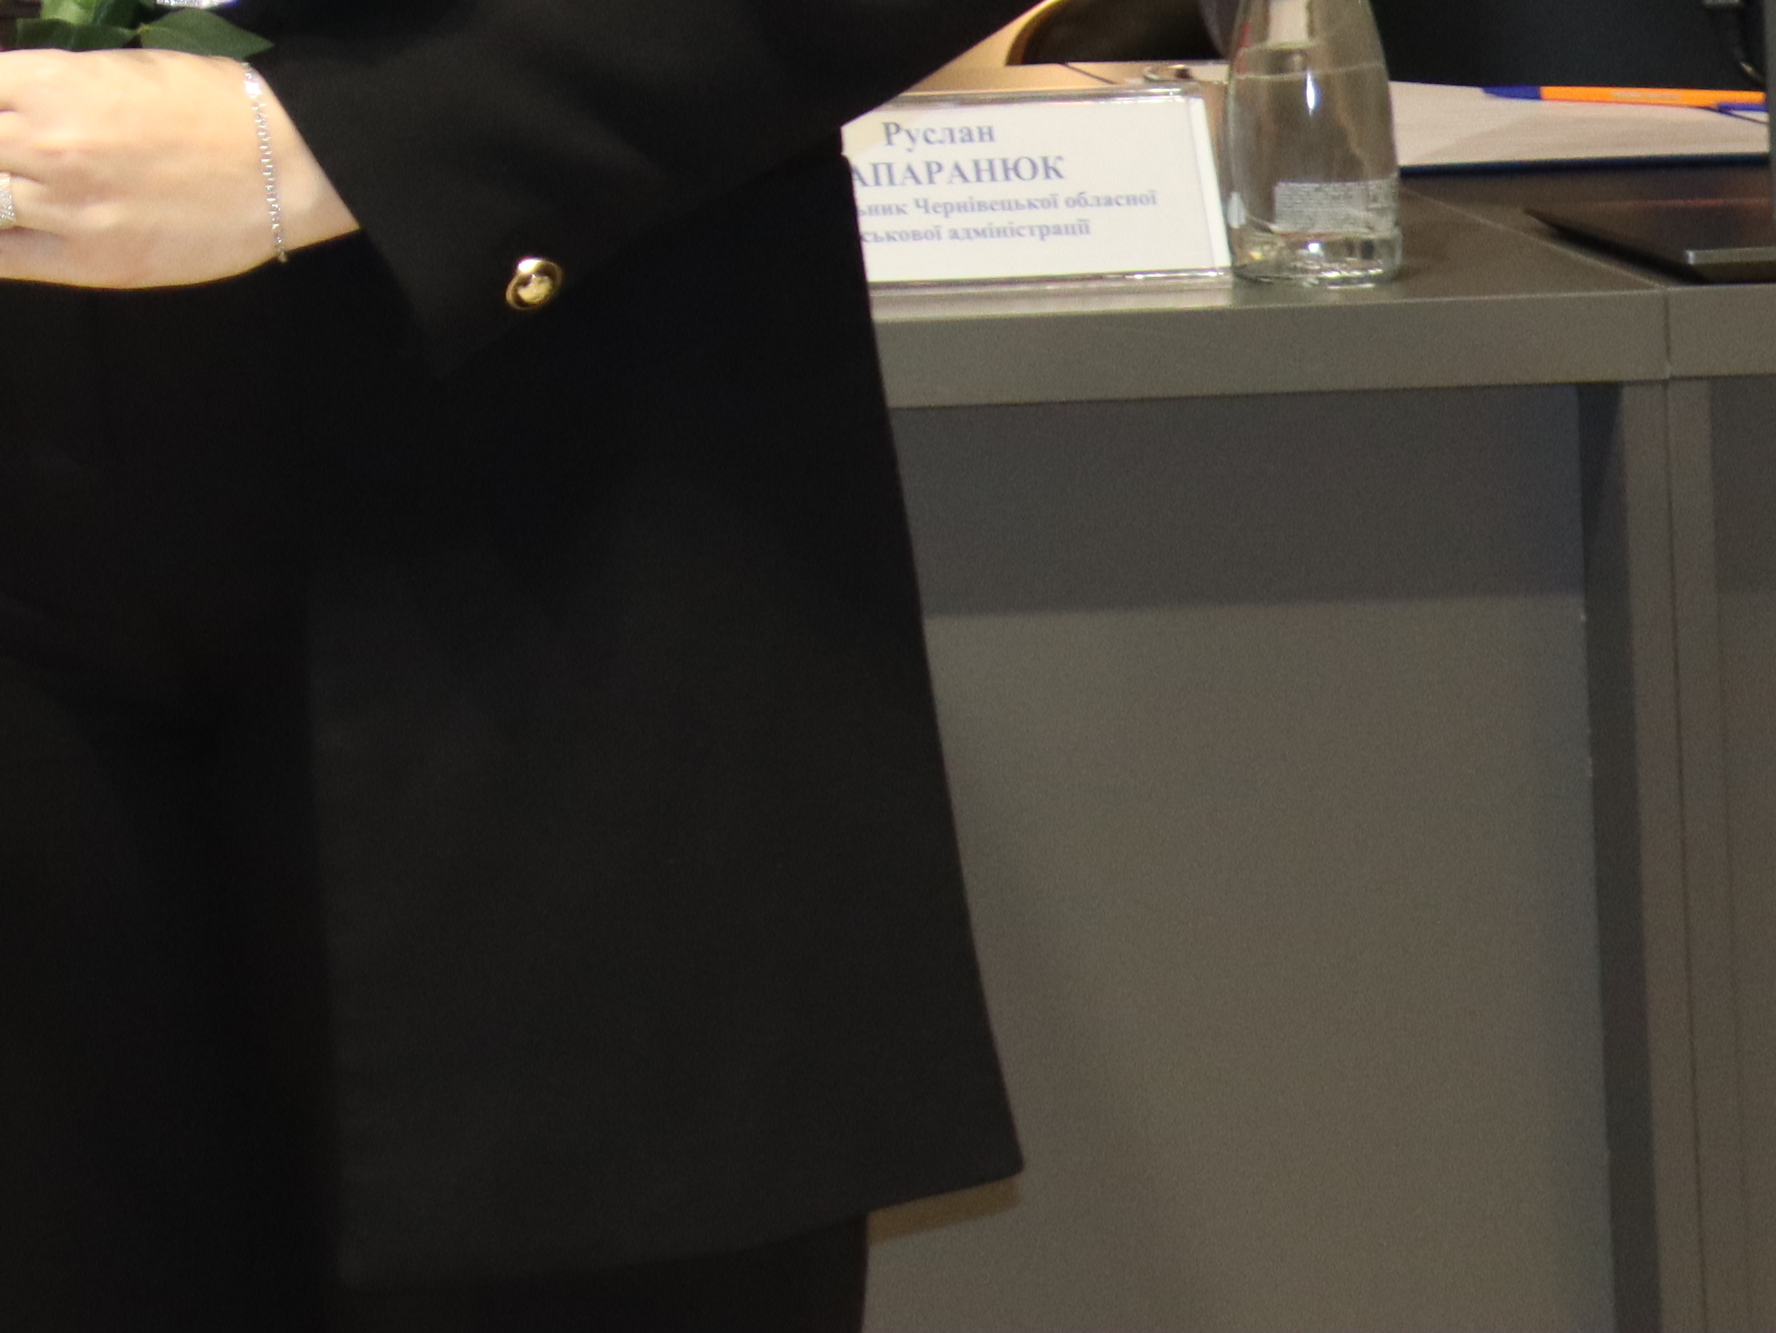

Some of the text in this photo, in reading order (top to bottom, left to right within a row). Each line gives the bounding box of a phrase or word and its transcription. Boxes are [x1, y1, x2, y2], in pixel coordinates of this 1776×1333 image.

[882, 120, 996, 152] Руслан
[850, 155, 1066, 187] АПАРАНЮК
[913, 192, 1059, 219] Чернівецької
[1064, 189, 1159, 209] обласної
